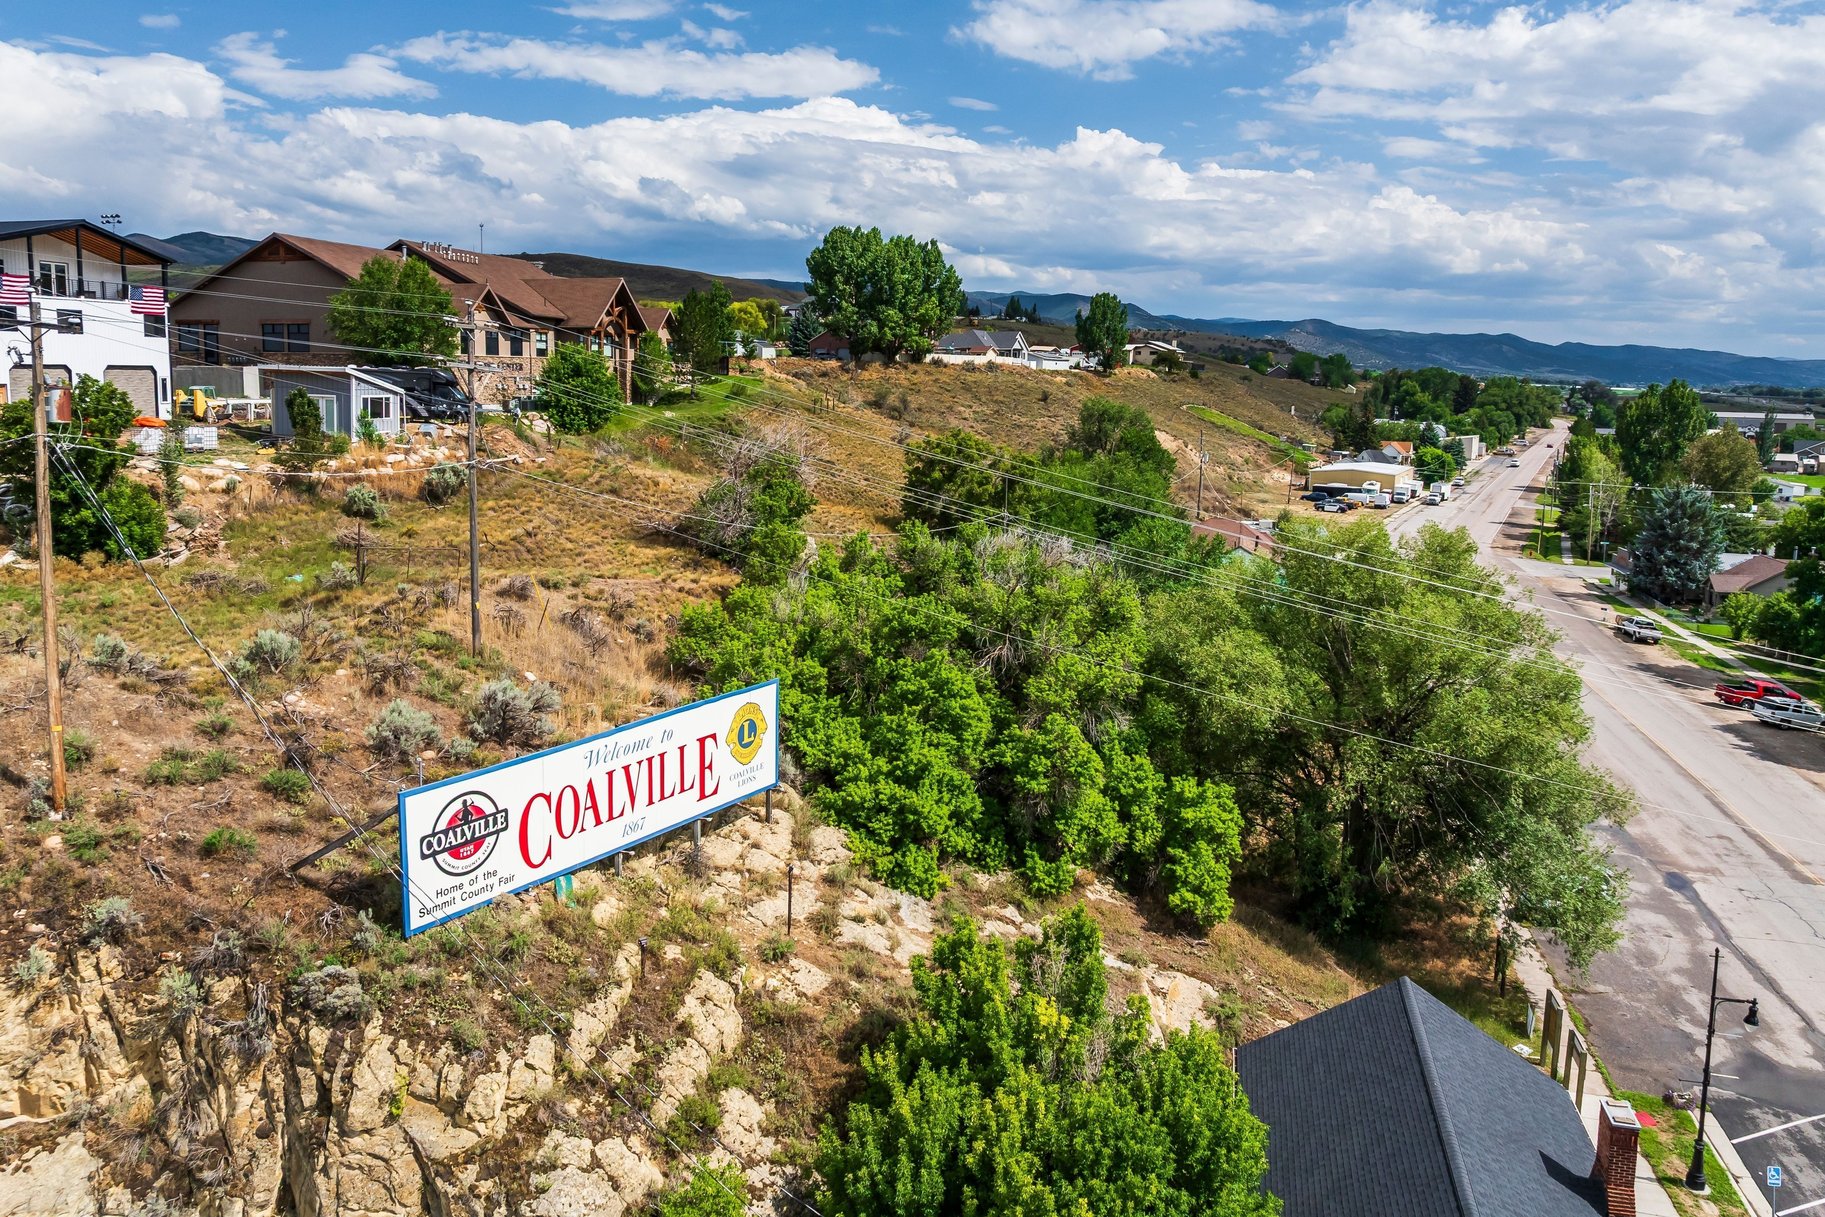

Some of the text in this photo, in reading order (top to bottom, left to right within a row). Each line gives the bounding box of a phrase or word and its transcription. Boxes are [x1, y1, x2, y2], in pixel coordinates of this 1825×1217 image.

[742, 721, 754, 744] L
[584, 728, 674, 769] Welcome to
[729, 762, 765, 781] COALVILLE
[737, 775, 757, 788] LIONS
[518, 732, 721, 869] COALVILLE
[422, 812, 507, 855] COALVILLE
[622, 817, 647, 838] 1867
[442, 858, 460, 870] SUMMIT
[461, 857, 481, 870] COUNTY
[418, 873, 515, 918] Summit County Fair
[436, 869, 498, 899] Home of the
